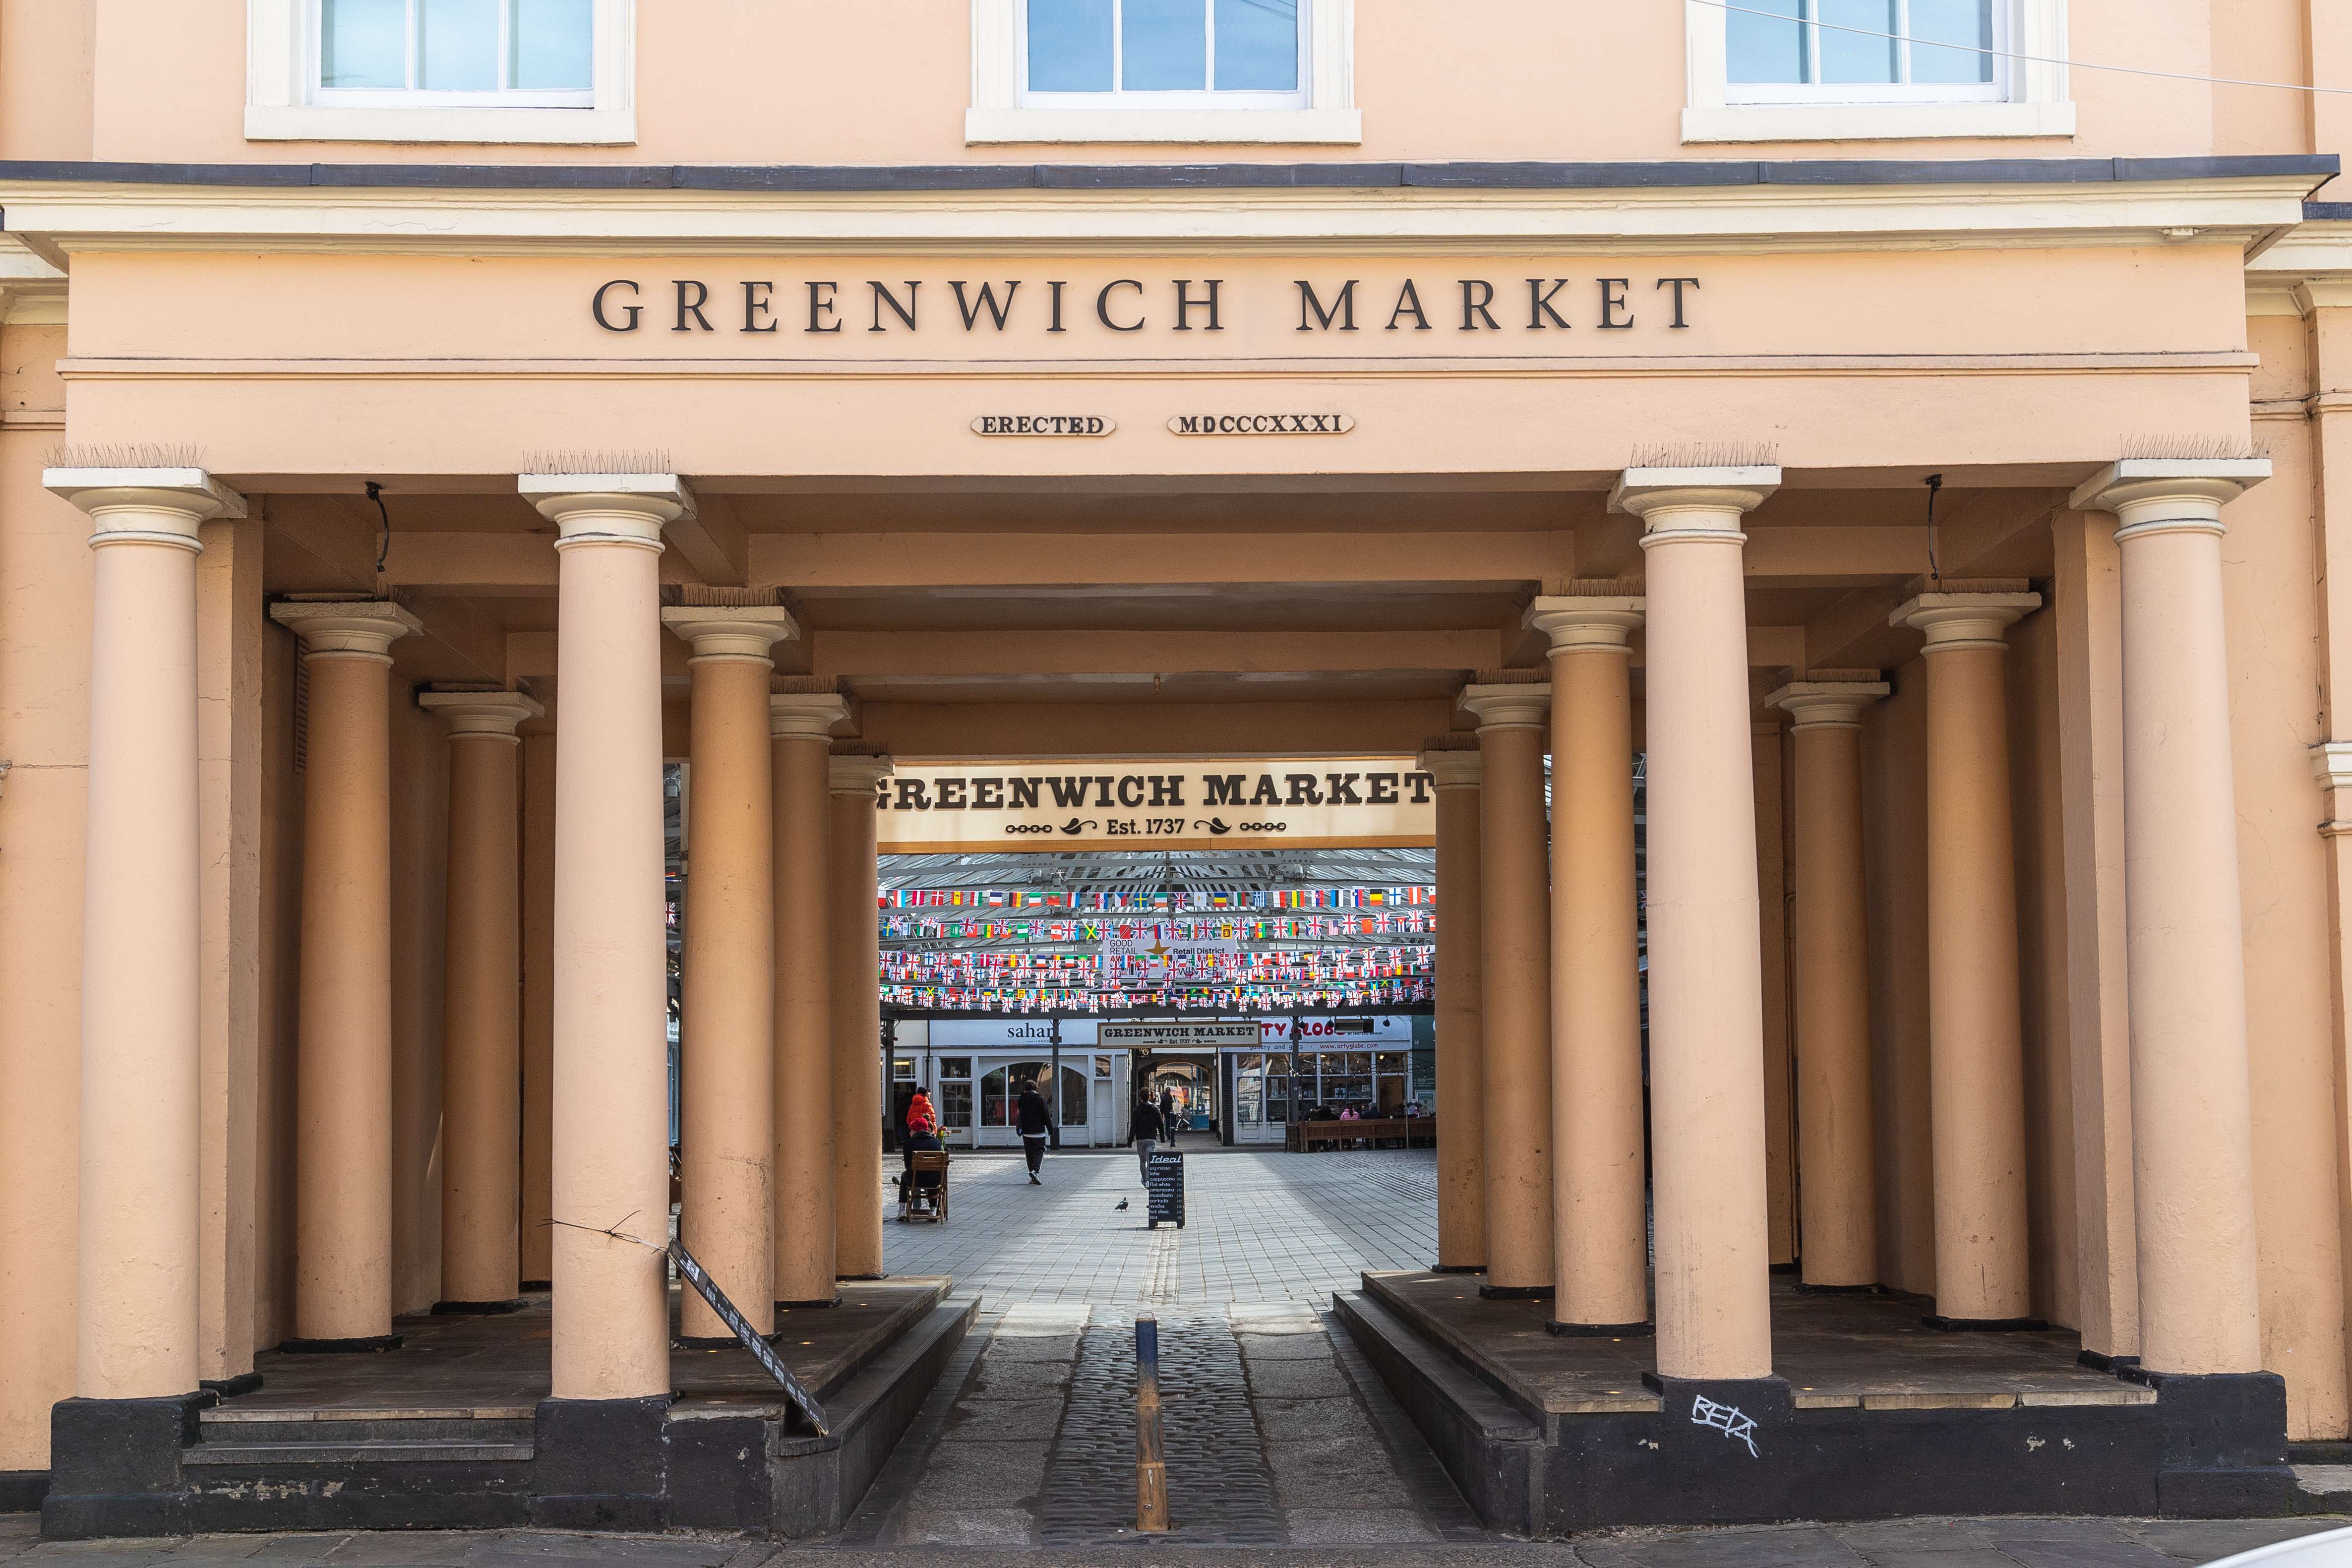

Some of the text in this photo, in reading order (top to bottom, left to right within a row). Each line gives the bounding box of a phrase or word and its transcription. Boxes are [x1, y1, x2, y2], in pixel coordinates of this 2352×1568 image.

[592, 278, 1700, 332] GREENWICH MARKET
[982, 415, 1342, 434] ERECTED MDCCCXXXI
[1203, 772, 1435, 806] MARKET
[1106, 818, 1185, 835] Est. 1737
[1178, 966, 1218, 975] WINER
[1104, 1026, 1255, 1037] GREENWICH MARKET
